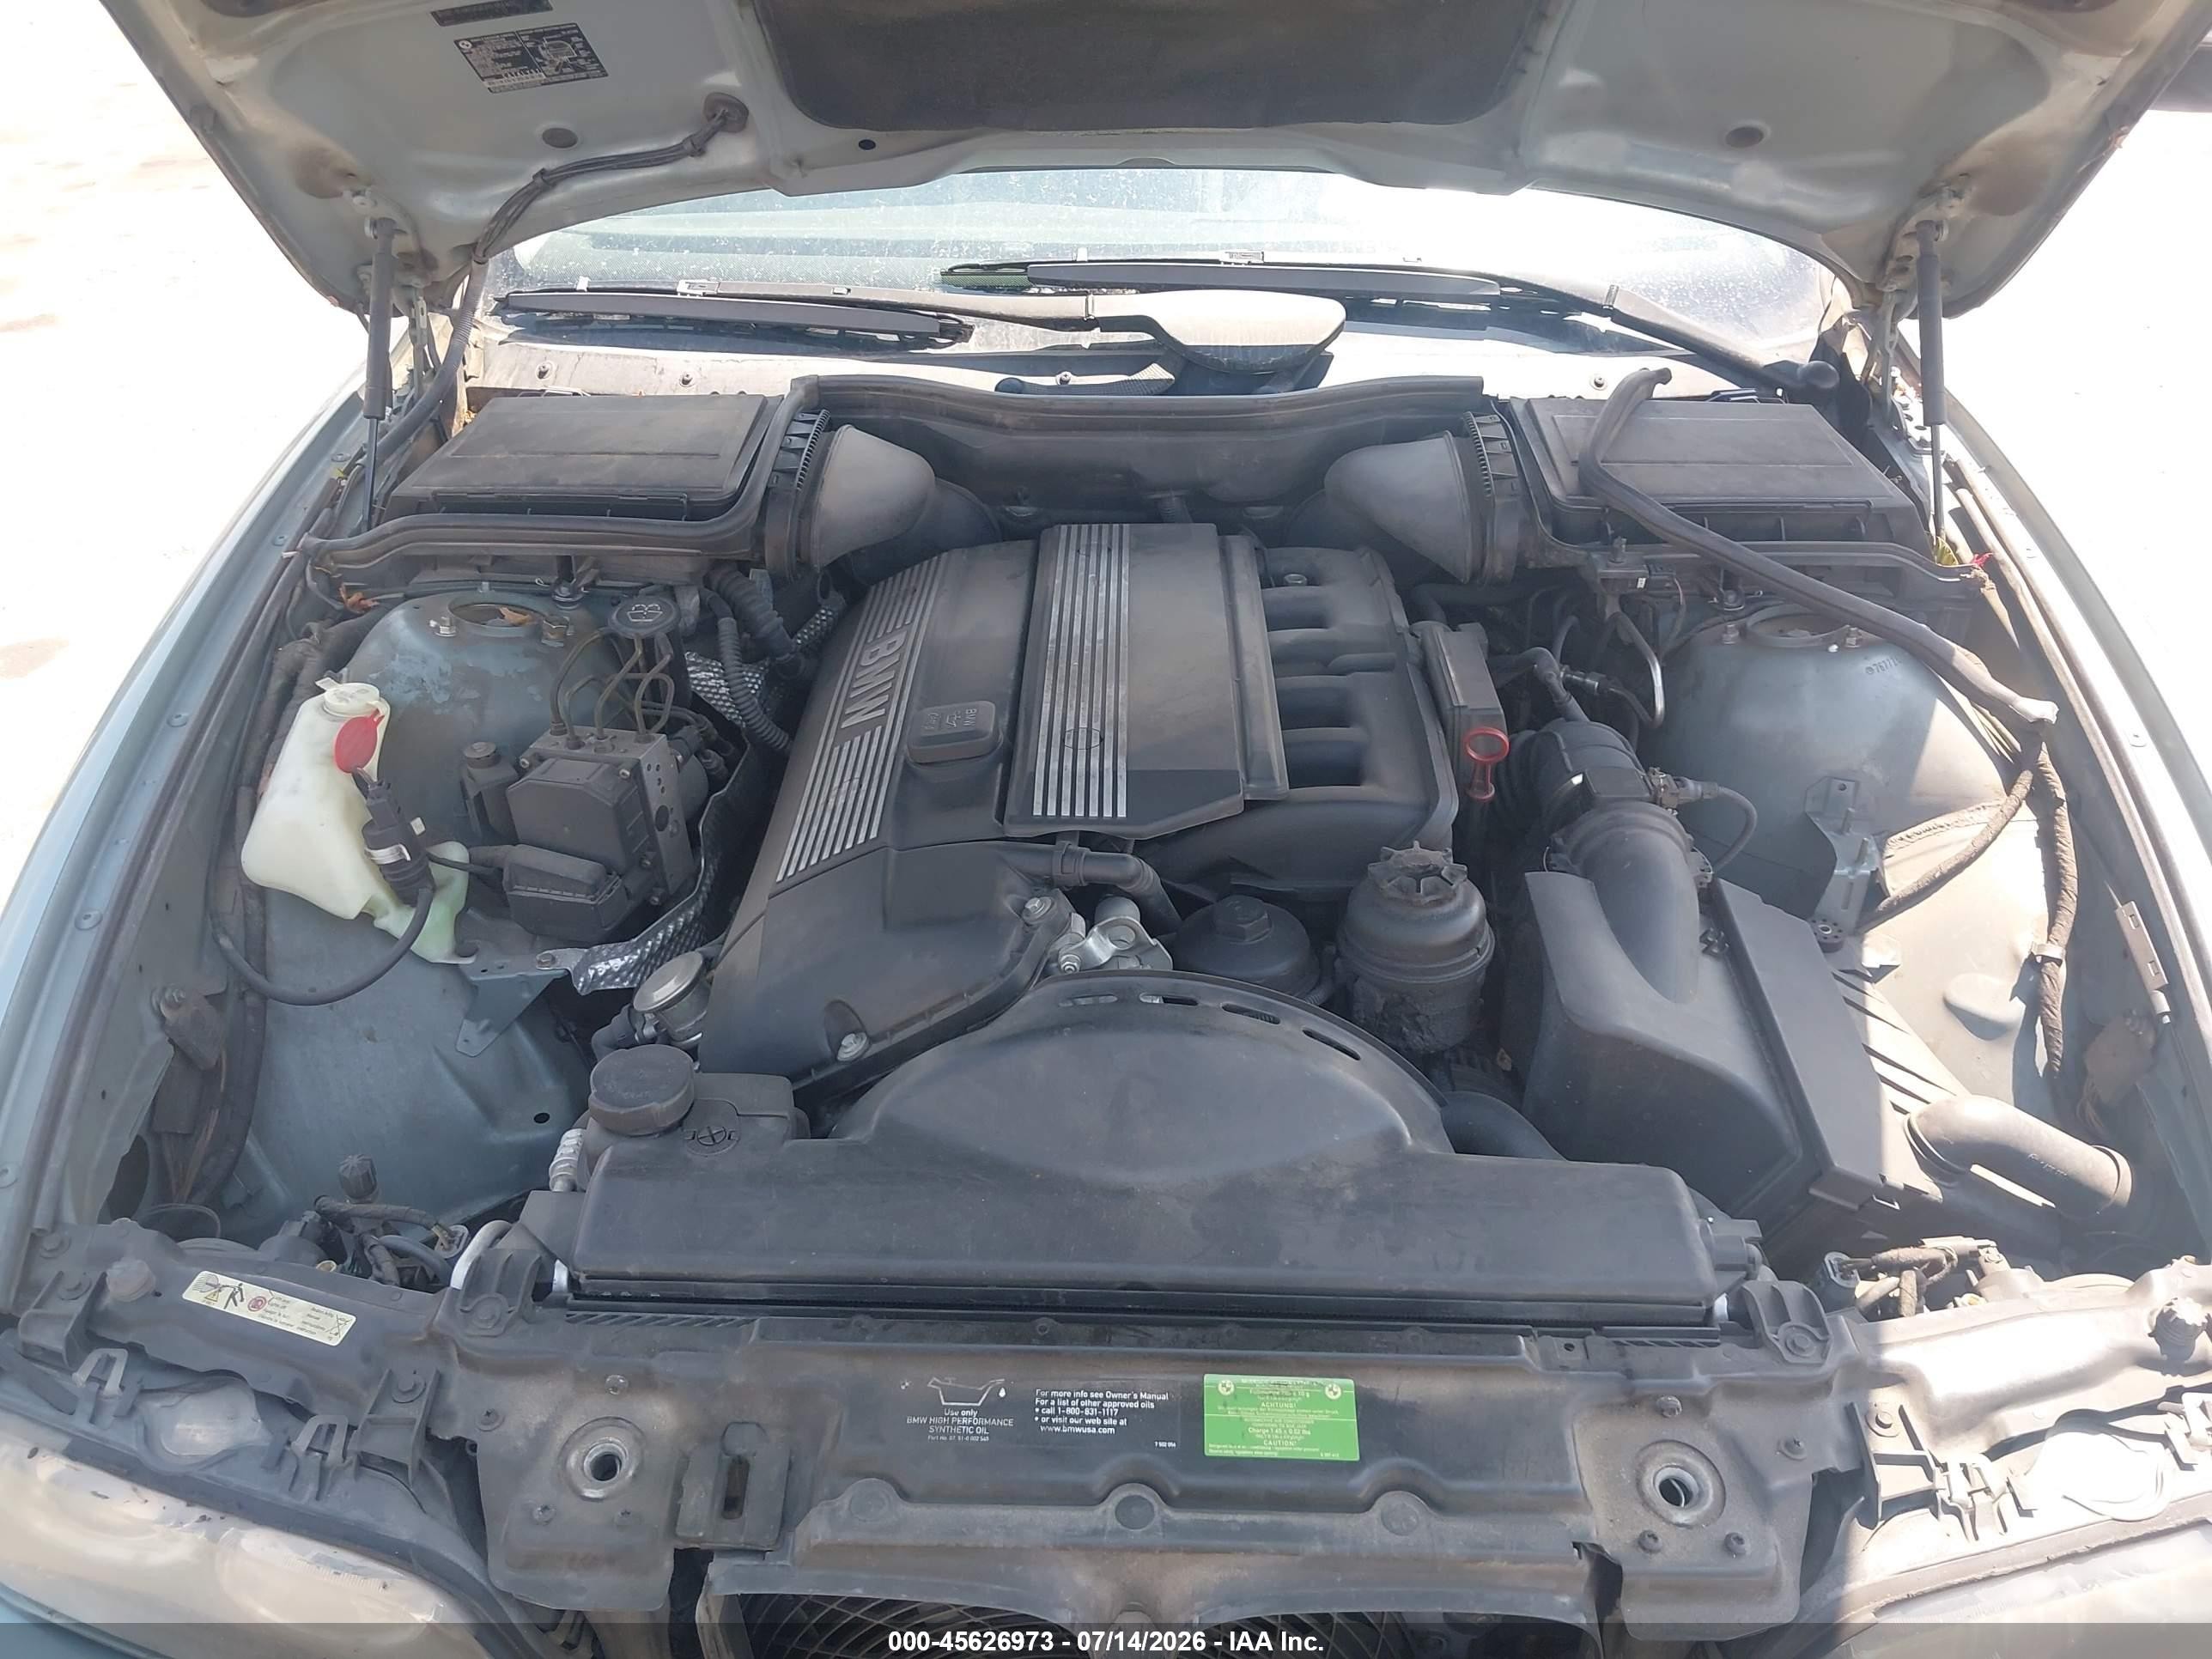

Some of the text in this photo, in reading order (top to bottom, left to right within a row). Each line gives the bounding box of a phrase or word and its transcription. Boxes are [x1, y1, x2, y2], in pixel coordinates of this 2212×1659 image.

[841, 630, 908, 728] BMW
[963, 708, 977, 726] BMW
[1036, 1389, 1048, 1397] For
[1073, 1389, 1088, 1398] info
[1105, 1390, 1139, 1400] Owner's
[1139, 1392, 1169, 1401] Manual
[1035, 1397, 1048, 1406] For
[1057, 1398, 1069, 1407] list
[1080, 1399, 1102, 1407] other
[1103, 1400, 1139, 1409] approved
[1140, 1400, 1155, 1408] oils
[961, 1408, 978, 1418] only
[1058, 1407, 1119, 1417] 1-800-831-1117
[929, 1416, 950, 1425] HIGH
[951, 1417, 1014, 1426] PERFORMANCE
[1051, 1415, 1067, 1424] visit
[1119, 1417, 1127, 1426] at
[928, 1425, 990, 1435] SYNTHETIC OIL
[1040, 1425, 1115, 1435] www.bmwusa.com
